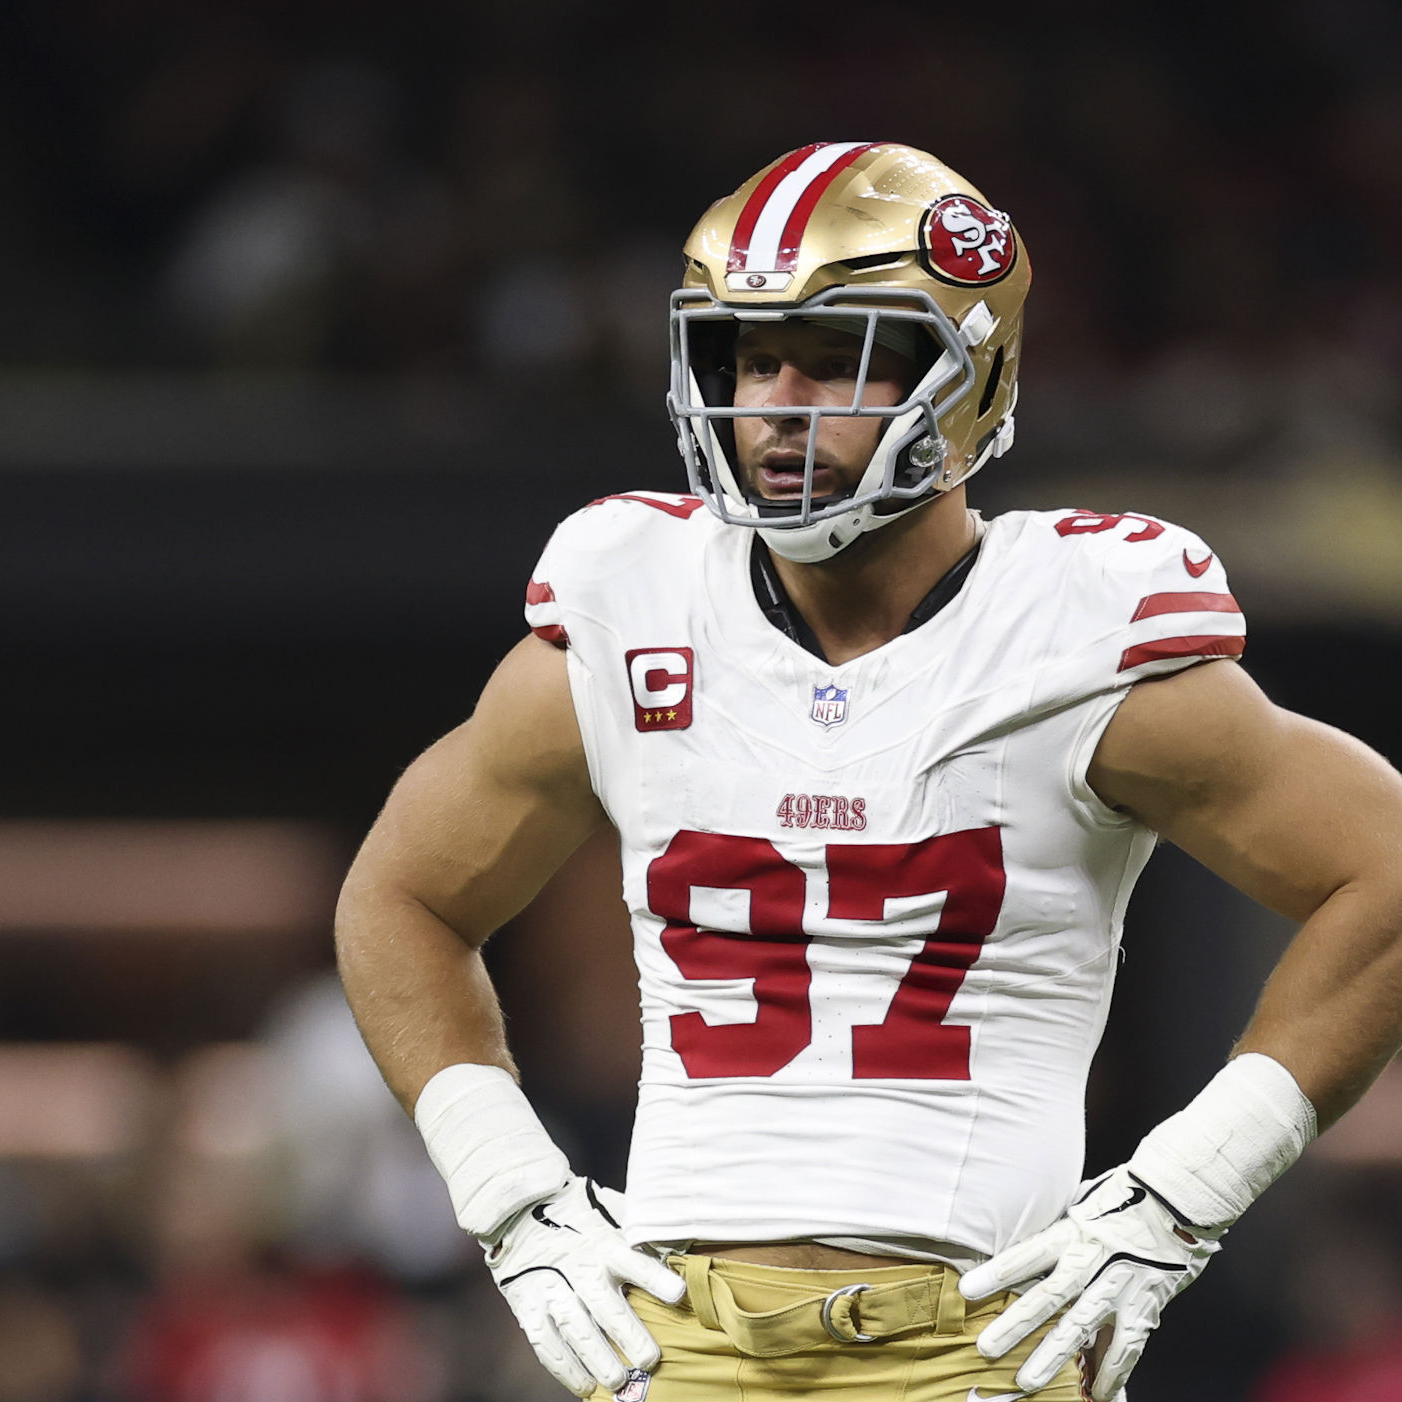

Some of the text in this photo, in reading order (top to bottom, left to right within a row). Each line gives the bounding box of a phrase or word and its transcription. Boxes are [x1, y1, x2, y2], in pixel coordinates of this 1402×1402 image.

[630, 652, 688, 709] C
[815, 702, 842, 722] NFL
[776, 793, 867, 831] 49ERS
[647, 825, 1006, 1080] 97
